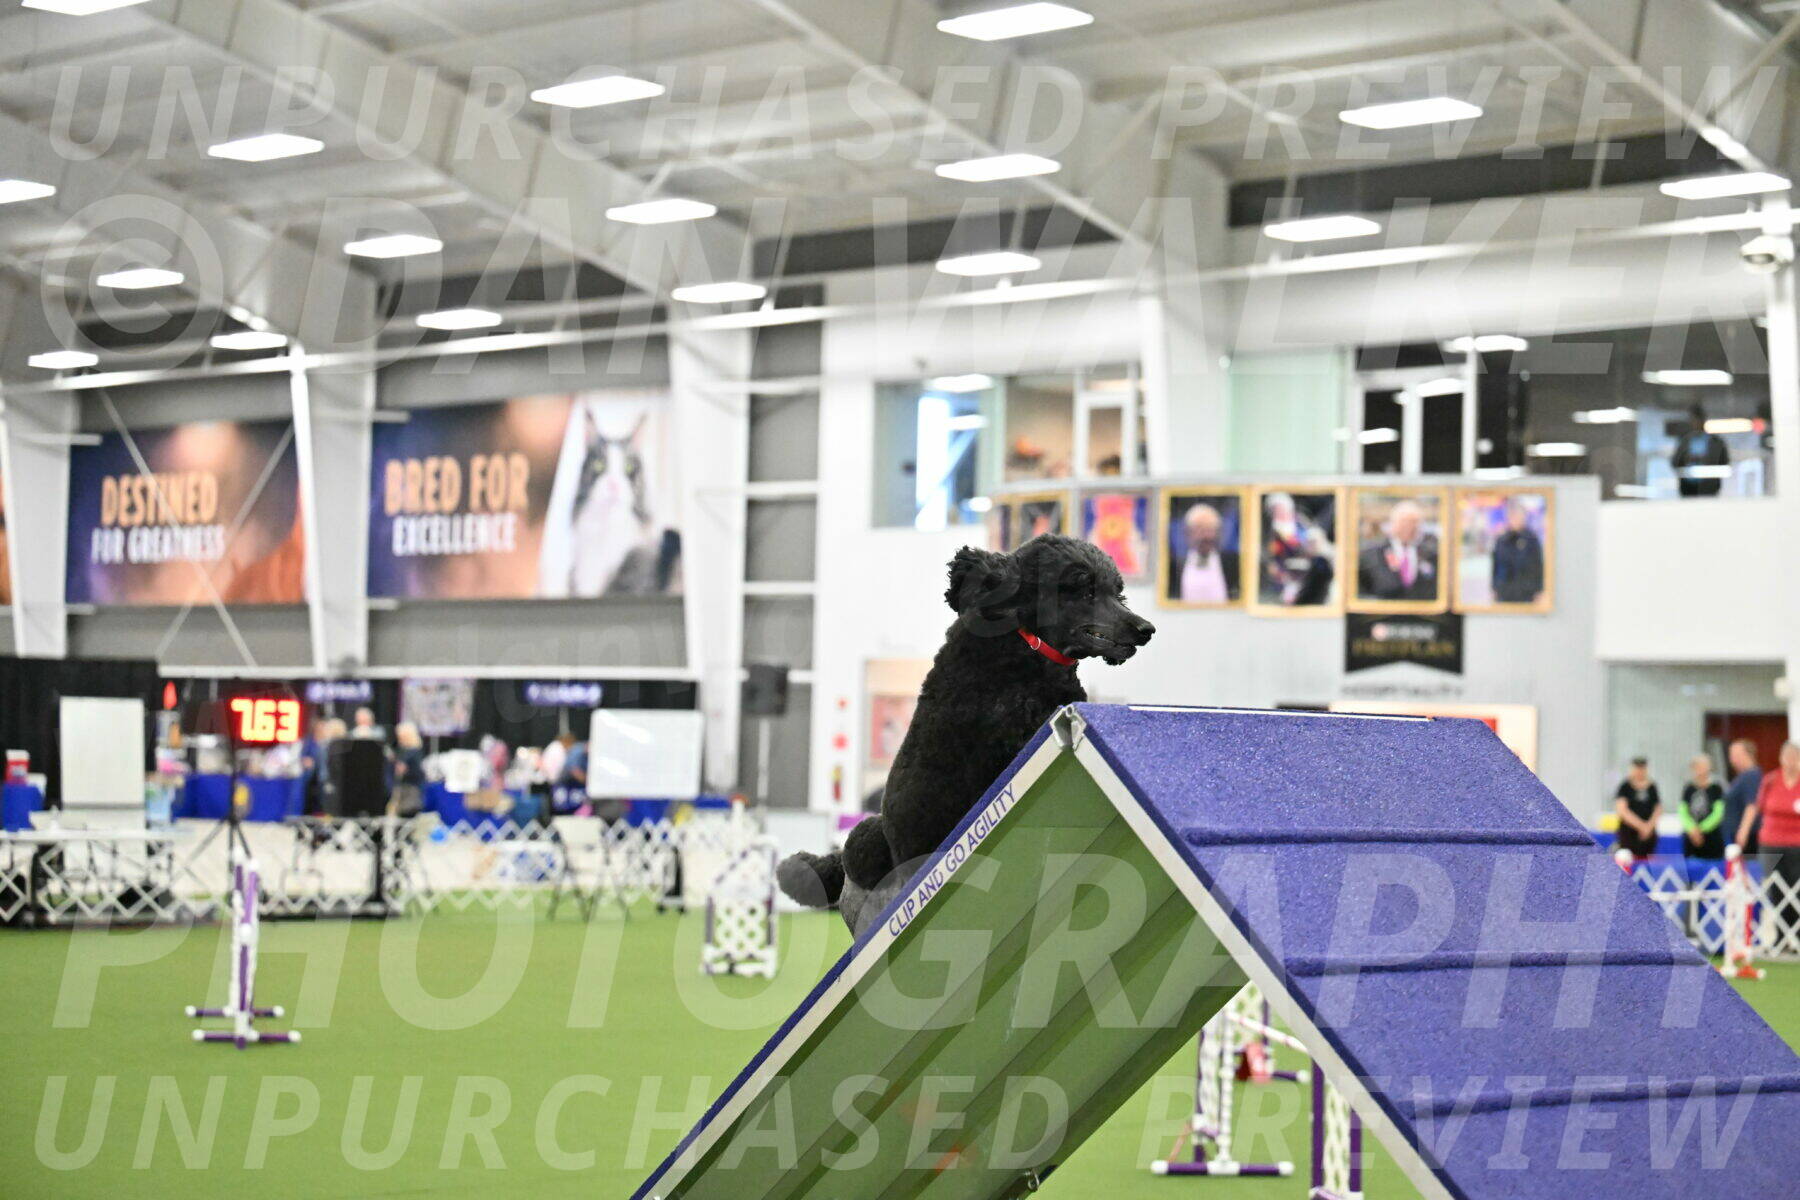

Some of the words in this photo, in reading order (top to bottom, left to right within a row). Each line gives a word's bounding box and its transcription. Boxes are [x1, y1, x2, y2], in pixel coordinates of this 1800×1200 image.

[102, 473, 218, 526] DESTINED
[385, 456, 461, 516] BRED
[470, 452, 530, 513] FOR
[392, 512, 518, 556] EXCELLENCE
[889, 898, 915, 937] CLIP
[918, 868, 944, 908] AND
[945, 843, 966, 873] GO
[967, 782, 1017, 852] AGILITY
